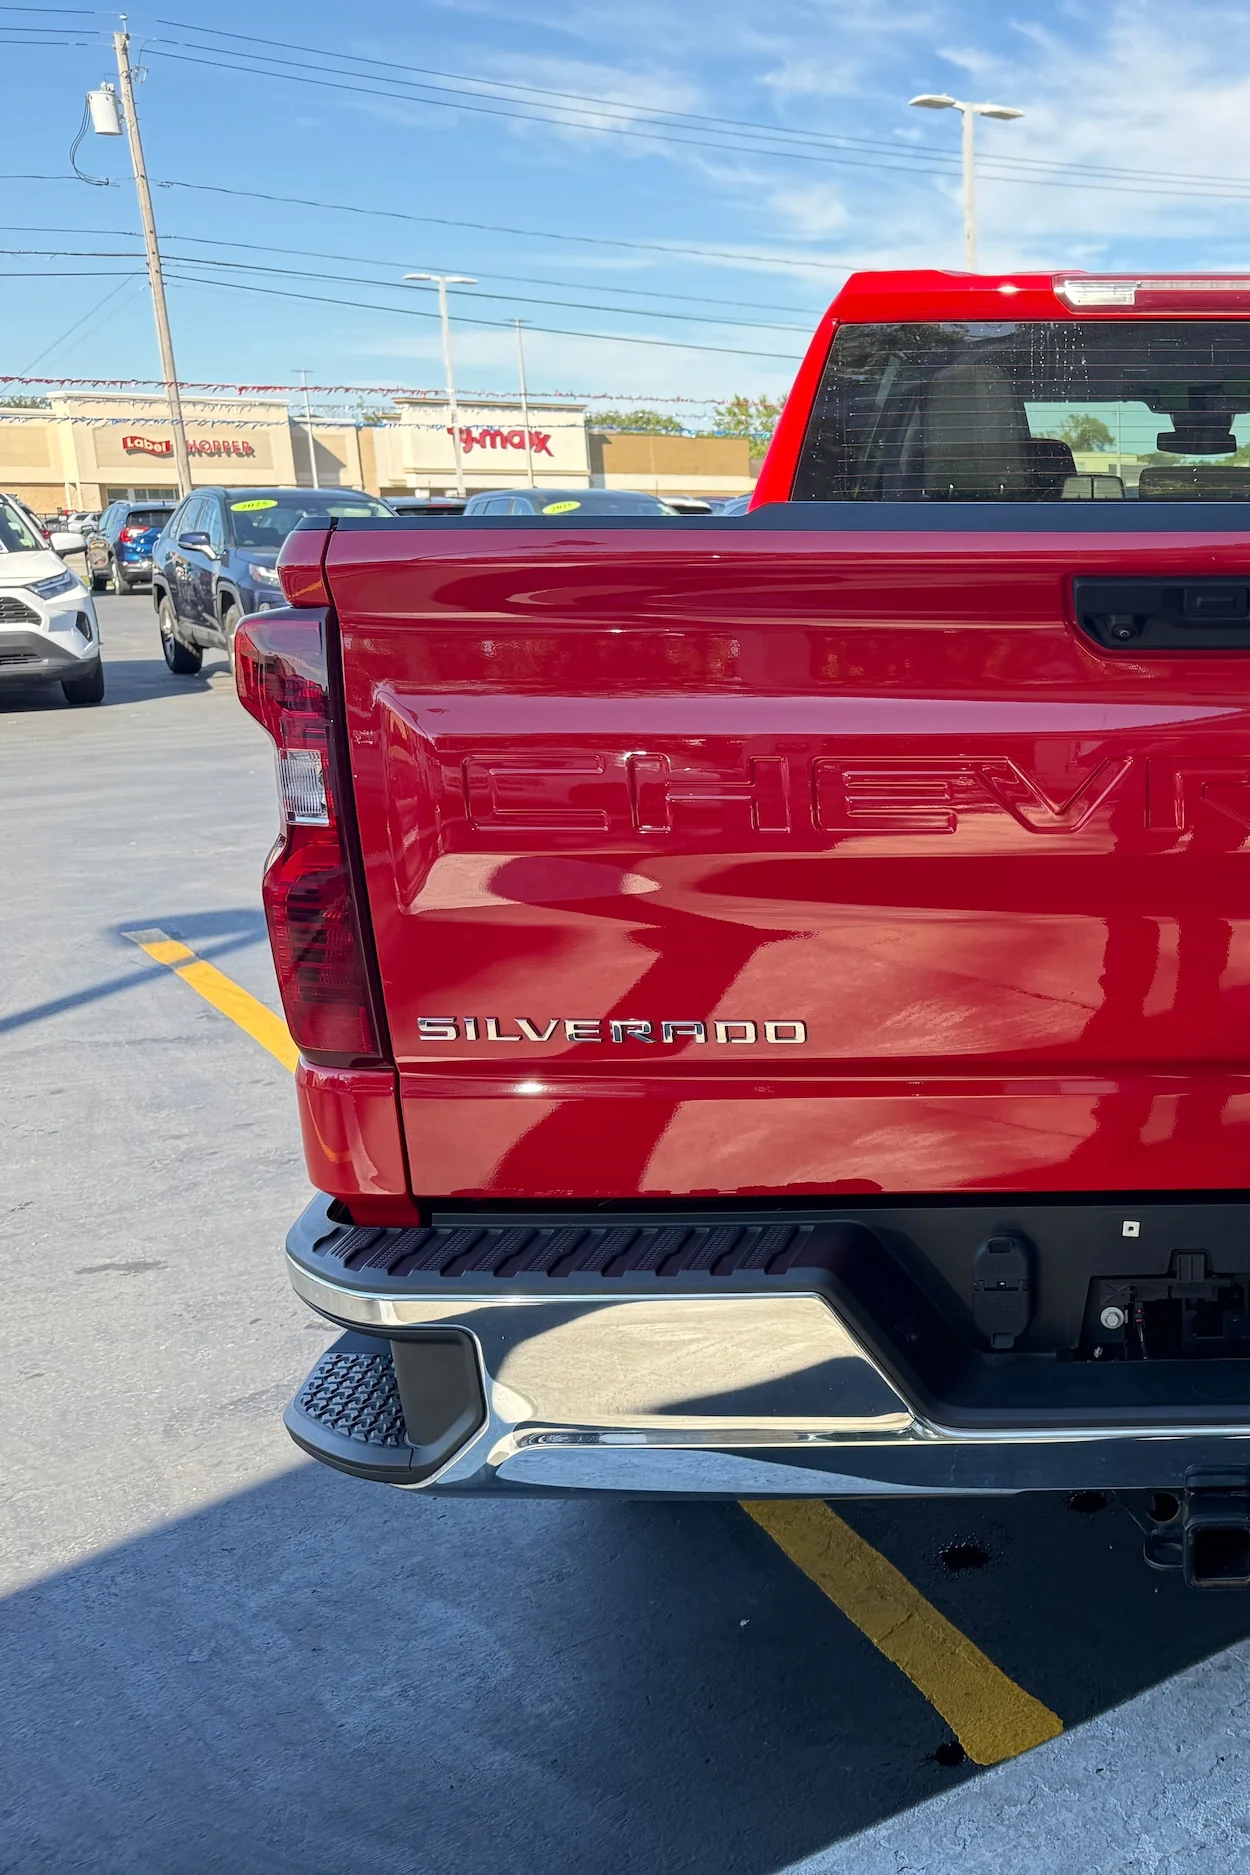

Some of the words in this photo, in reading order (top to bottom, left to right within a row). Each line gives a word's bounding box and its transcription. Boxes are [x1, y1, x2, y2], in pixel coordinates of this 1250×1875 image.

[126, 436, 167, 453] Label
[184, 439, 252, 454] HOPPER
[416, 1015, 809, 1045] SILVERADO
